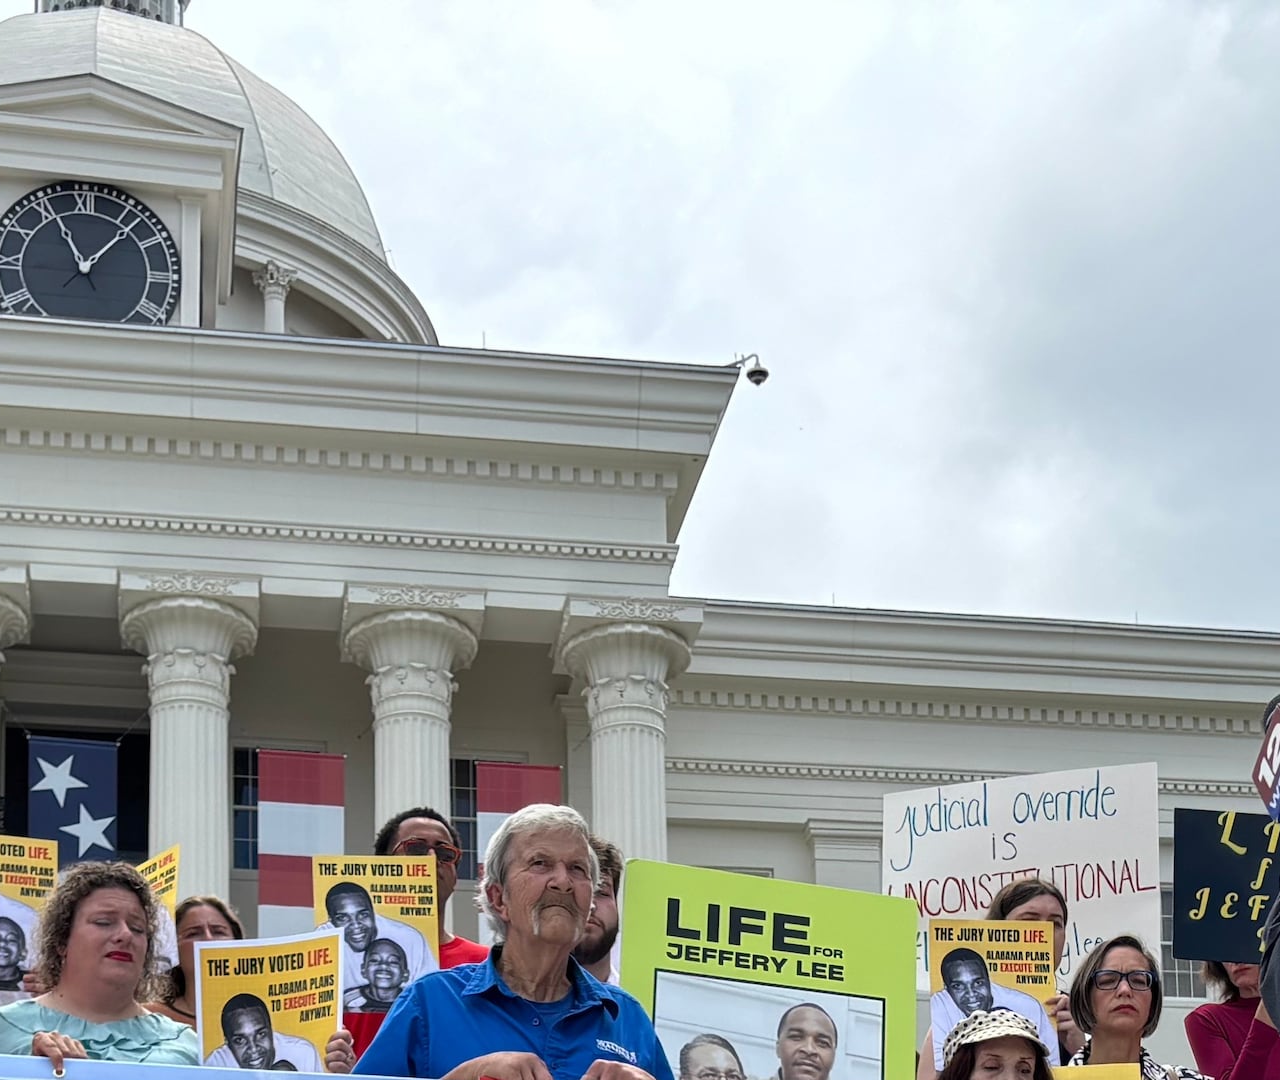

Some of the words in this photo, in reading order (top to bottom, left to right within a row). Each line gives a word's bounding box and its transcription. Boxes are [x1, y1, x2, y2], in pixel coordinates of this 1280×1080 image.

[890, 782, 988, 872] judicial
[1013, 769, 1117, 825] override
[28, 846, 52, 860] LIFE.
[992, 832, 1018, 861] is
[30, 866, 54, 877] PLANS
[319, 863, 338, 876] THE
[341, 863, 368, 876] JURY
[371, 864, 403, 877] VOTED
[406, 865, 431, 877] LIFE.
[5, 874, 37, 886] EXECUTE
[39, 878, 54, 889] HIM
[370, 884, 407, 894] ALABAMA
[409, 884, 433, 894] PLANS
[372, 895, 382, 904] TO
[384, 895, 416, 905] EXECUTE
[418, 896, 433, 905] HIM
[400, 907, 434, 917] ANYWAY.
[666, 897, 811, 956] LIFE
[813, 946, 843, 959] FOR
[935, 927, 954, 942] THE
[957, 927, 984, 943] JURY
[987, 928, 1020, 943] VOTED
[1023, 930, 1048, 944] LIFE.
[207, 959, 230, 977] THE
[234, 957, 265, 976] JURY
[269, 952, 304, 973] VOTED
[308, 948, 333, 968] LIFE.
[666, 942, 788, 974] JEFFERY
[796, 960, 844, 982] LEE
[986, 950, 1024, 961] ALABAMA
[1026, 951, 1050, 961] PLANS
[1000, 963, 1033, 973] EXECUTE
[1034, 963, 1050, 973] HIM
[268, 979, 307, 997] ALABAMA
[310, 974, 334, 990] PLANS
[271, 999, 281, 1012] TO
[283, 993, 317, 1010] EXECUTE
[318, 989, 334, 1004] HIM
[299, 1005, 334, 1023] ANYWAY.
